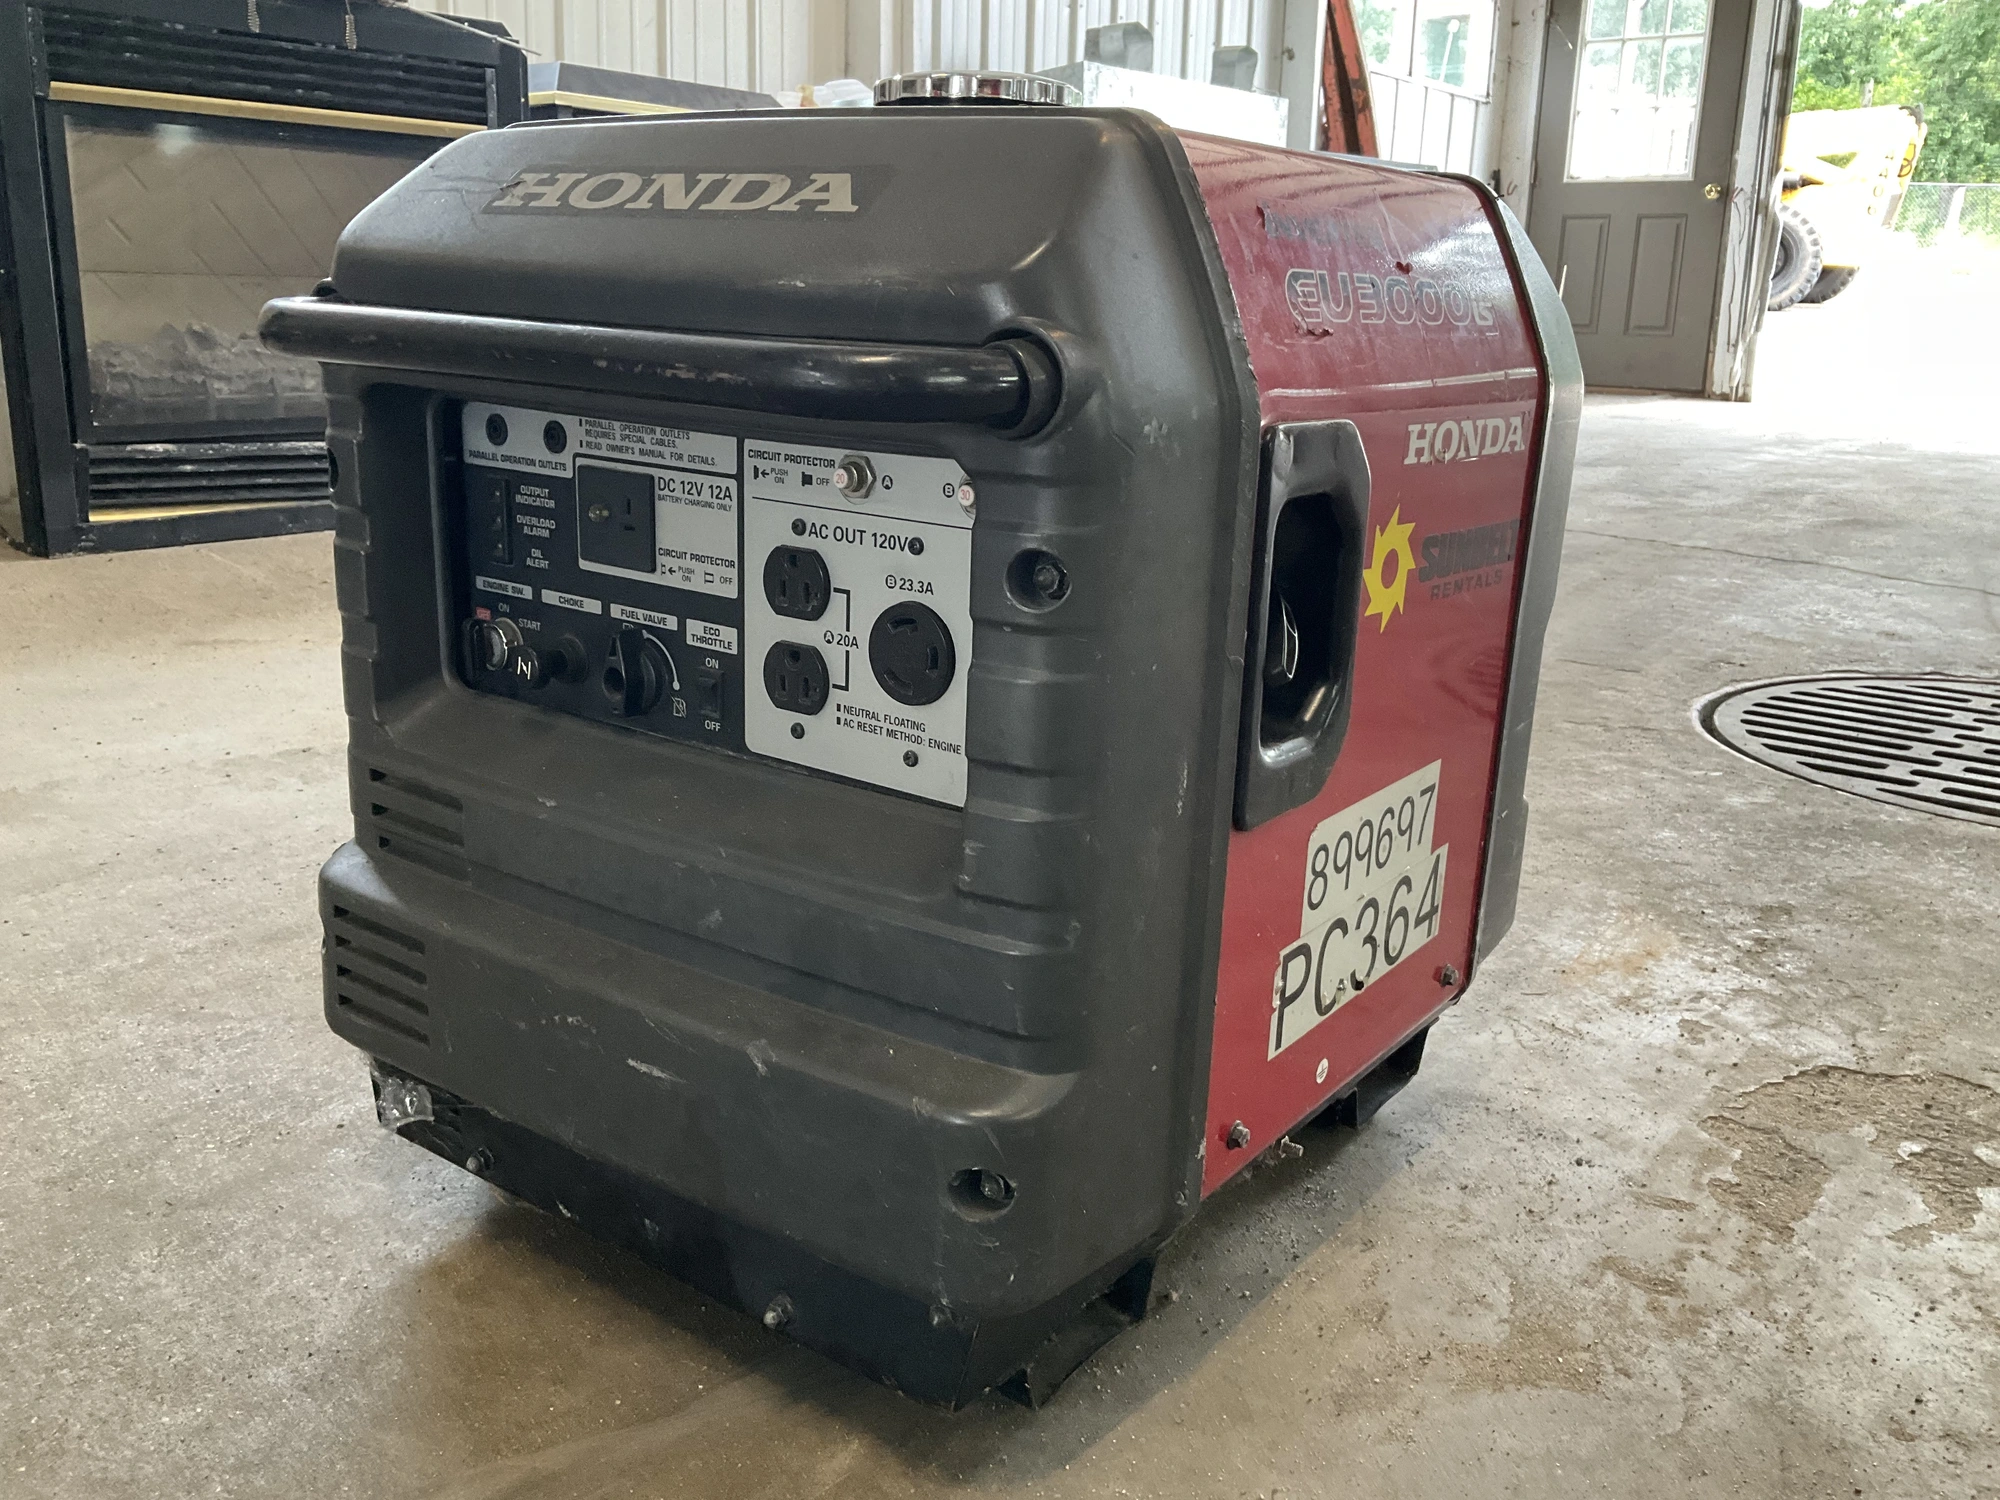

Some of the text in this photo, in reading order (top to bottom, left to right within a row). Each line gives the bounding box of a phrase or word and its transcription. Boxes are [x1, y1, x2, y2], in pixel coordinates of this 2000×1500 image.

[492, 171, 859, 213] HONDA
[584, 418, 690, 440] PARALLEL OPERATION OUTLETS
[585, 428, 678, 449] REQUIRES SPECIAL CABLES.
[1404, 415, 1526, 466] HONDA
[468, 450, 567, 472] PARALLEL OPERATION OUTLETS
[586, 441, 717, 466] READ OWNER'S MANUAL FOR DETAILS.
[748, 448, 836, 468] CIRCUIT PROTECTOR
[770, 467, 788, 477] PUSH
[836, 473, 845, 485] 20
[774, 475, 785, 485] ON
[816, 477, 830, 487] OFF
[520, 484, 550, 498] OUTPUT
[658, 476, 733, 502] DC 12V 12A
[960, 489, 970, 501] 30
[515, 494, 556, 509] INDICATOR
[657, 494, 732, 512] BATTERY CHARGING ONLY
[516, 514, 556, 529] OVERLOAD
[523, 526, 550, 538] ALARM
[808, 522, 908, 552] AC OUT 120V
[531, 548, 544, 558] OIL
[658, 547, 736, 569] CIRCUIT PROTECTOR
[526, 557, 550, 570] ALERT
[678, 565, 695, 576] PUSH
[482, 580, 510, 593] ENGINE
[682, 575, 692, 583] ON
[719, 576, 734, 586] OFF
[1430, 570, 1503, 600] RENTALS
[898, 578, 934, 596] 23.3A
[498, 602, 510, 614] ON
[558, 595, 584, 609] CHOKE
[620, 608, 668, 626] FUEL VALVE
[518, 618, 542, 632] START
[703, 626, 721, 637] ECO
[691, 633, 733, 650] THROTTLE
[836, 633, 860, 650] 20A
[705, 657, 719, 669] ON
[704, 720, 721, 732] OFF
[843, 704, 926, 733] NEUTRAL FLOATING
[842, 718, 962, 755] AC RESET METHOD: ENGINE
[1307, 782, 1436, 911] 899697
[1274, 852, 1441, 1052] PC364
